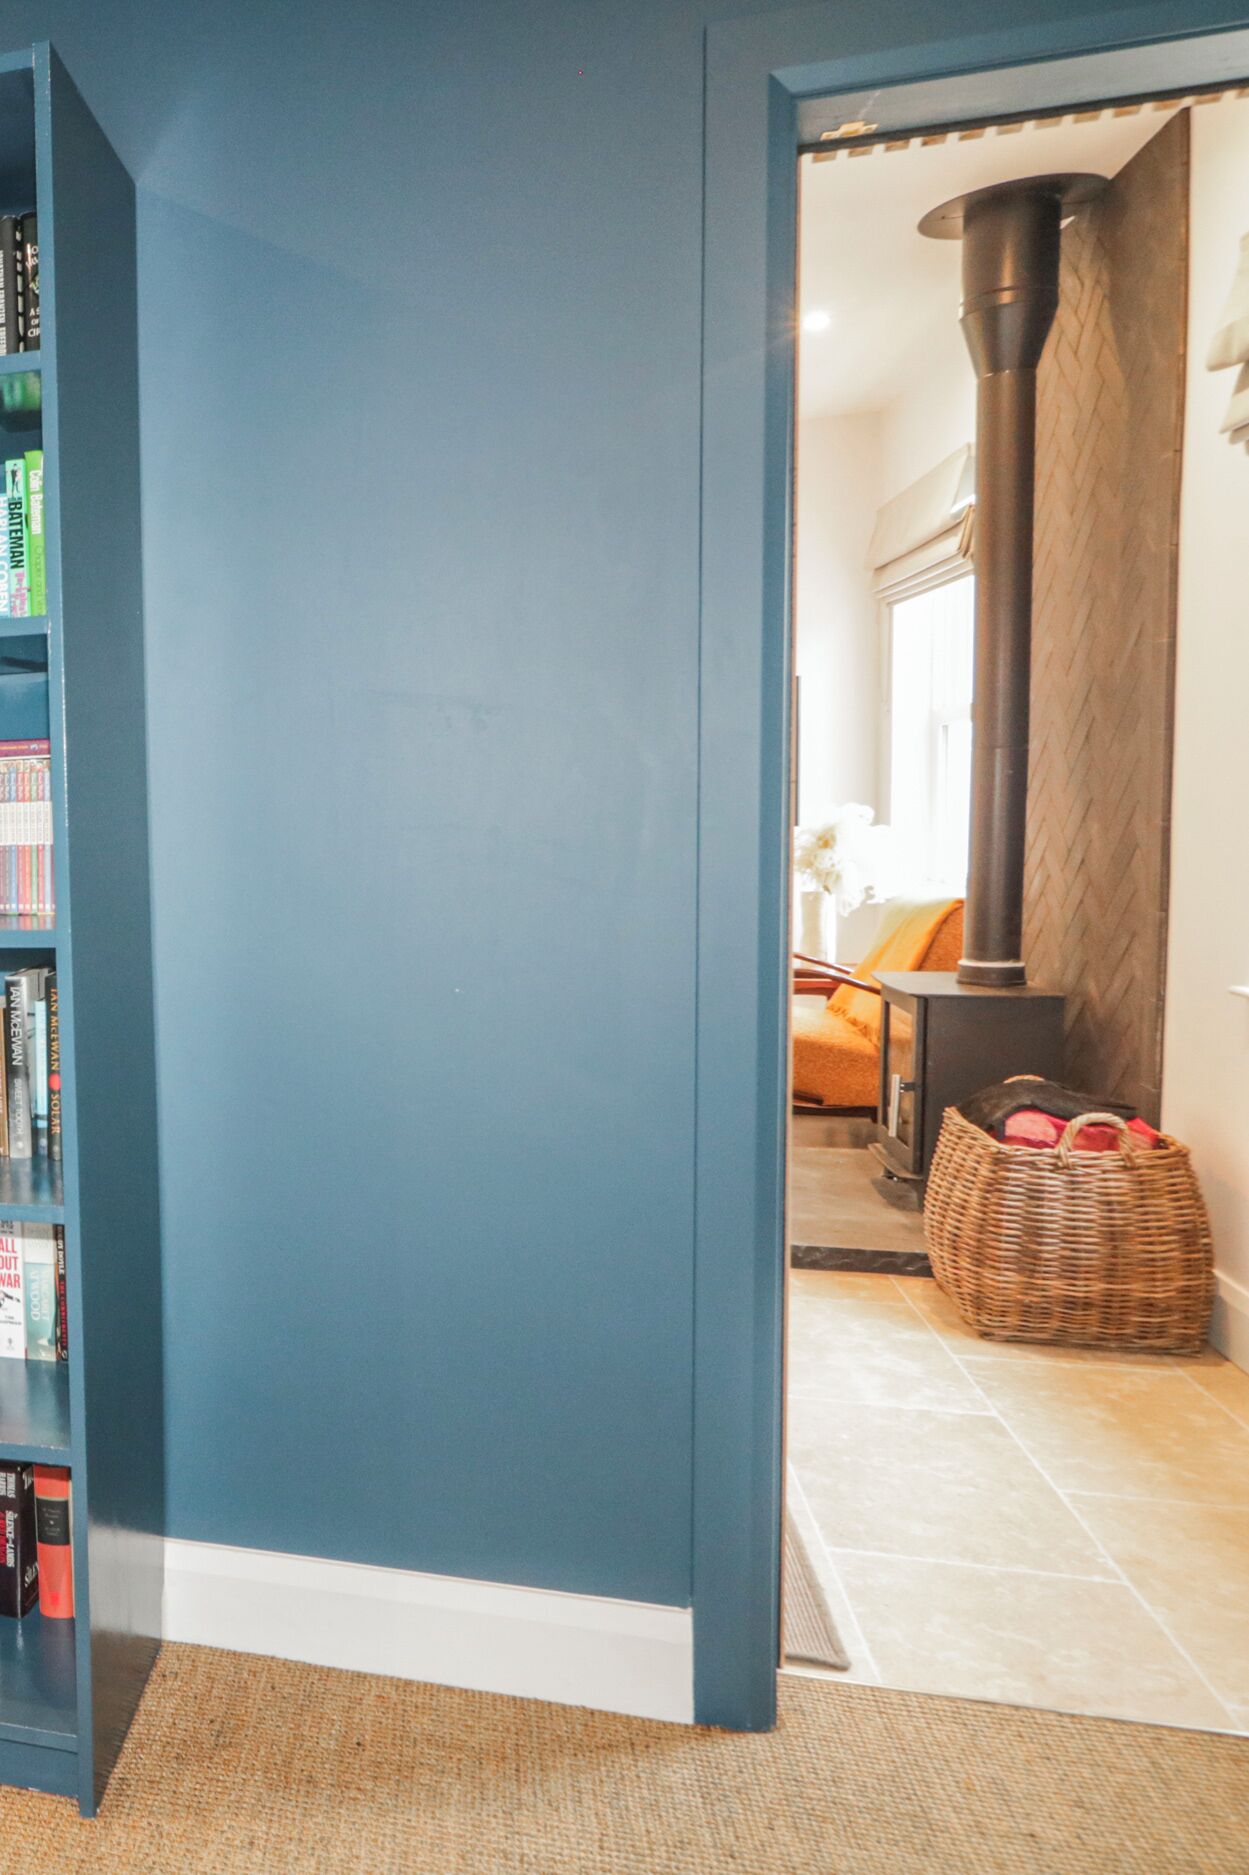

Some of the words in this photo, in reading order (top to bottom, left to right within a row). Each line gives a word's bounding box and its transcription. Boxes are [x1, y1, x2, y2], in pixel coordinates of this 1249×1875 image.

[8, 501, 25, 570] BATEMAN
[10, 986, 23, 1007] IAN
[50, 989, 58, 1012] IAN
[10, 1010, 23, 1066] McEWAN
[50, 1015, 60, 1070] McEWAN
[14, 1078, 23, 1105] SWEET
[14, 1108, 24, 1135] TOOTH
[50, 1094, 60, 1135] SOLAR
[30, 1268, 40, 1320] ATWOOD
[6, 1472, 16, 1498] THOMAS
